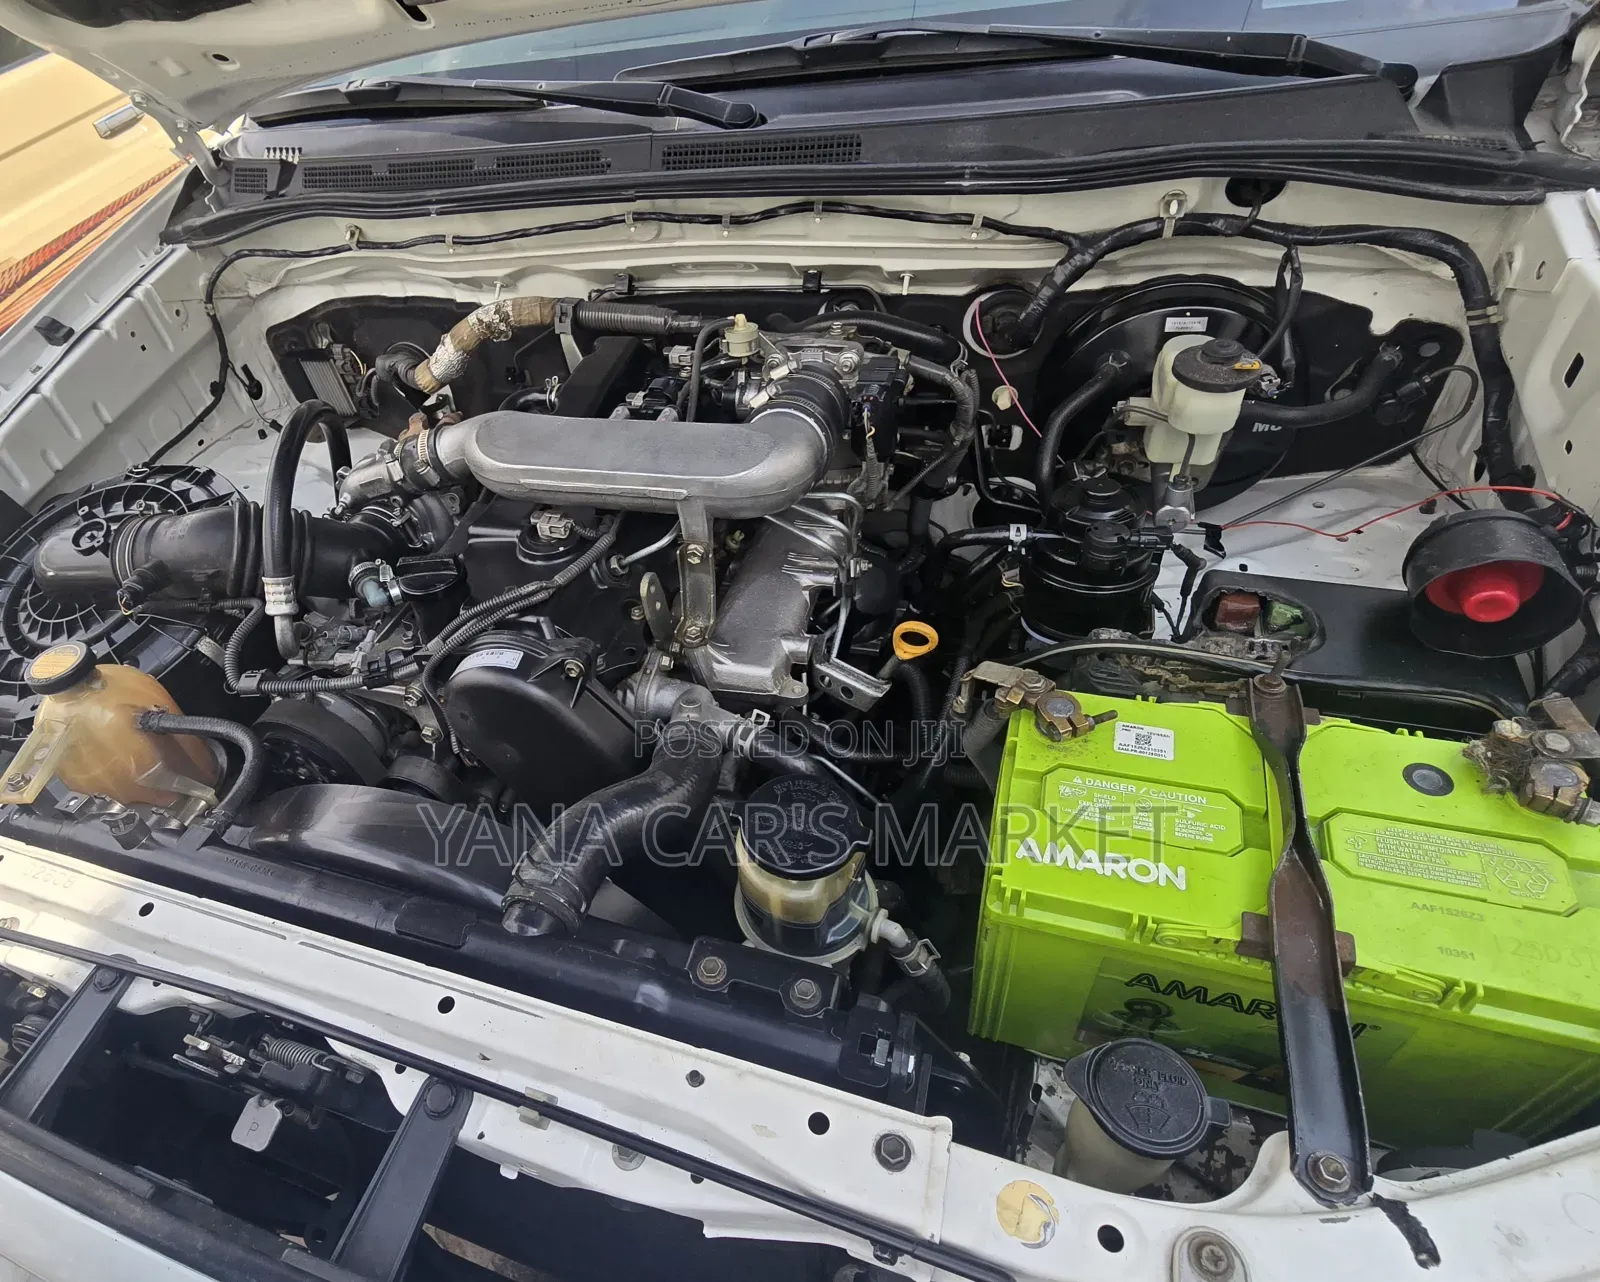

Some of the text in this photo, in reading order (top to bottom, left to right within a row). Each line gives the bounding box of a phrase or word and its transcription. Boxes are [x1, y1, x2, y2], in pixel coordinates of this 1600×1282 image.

[1086, 778, 1136, 793] DANGER
[1149, 788, 1207, 805] CAUTION
[1174, 817, 1208, 827] SULFURIC
[1375, 836, 1468, 856] FLUSH EYES IMMEDIATELY
[1376, 842, 1396, 850] WITH
[1377, 848, 1409, 858] MEDICAL
[1410, 853, 1429, 862] HELP
[1015, 837, 1187, 891] AMARON
[1436, 946, 1476, 961] 10351
[246, 1121, 259, 1137] P
